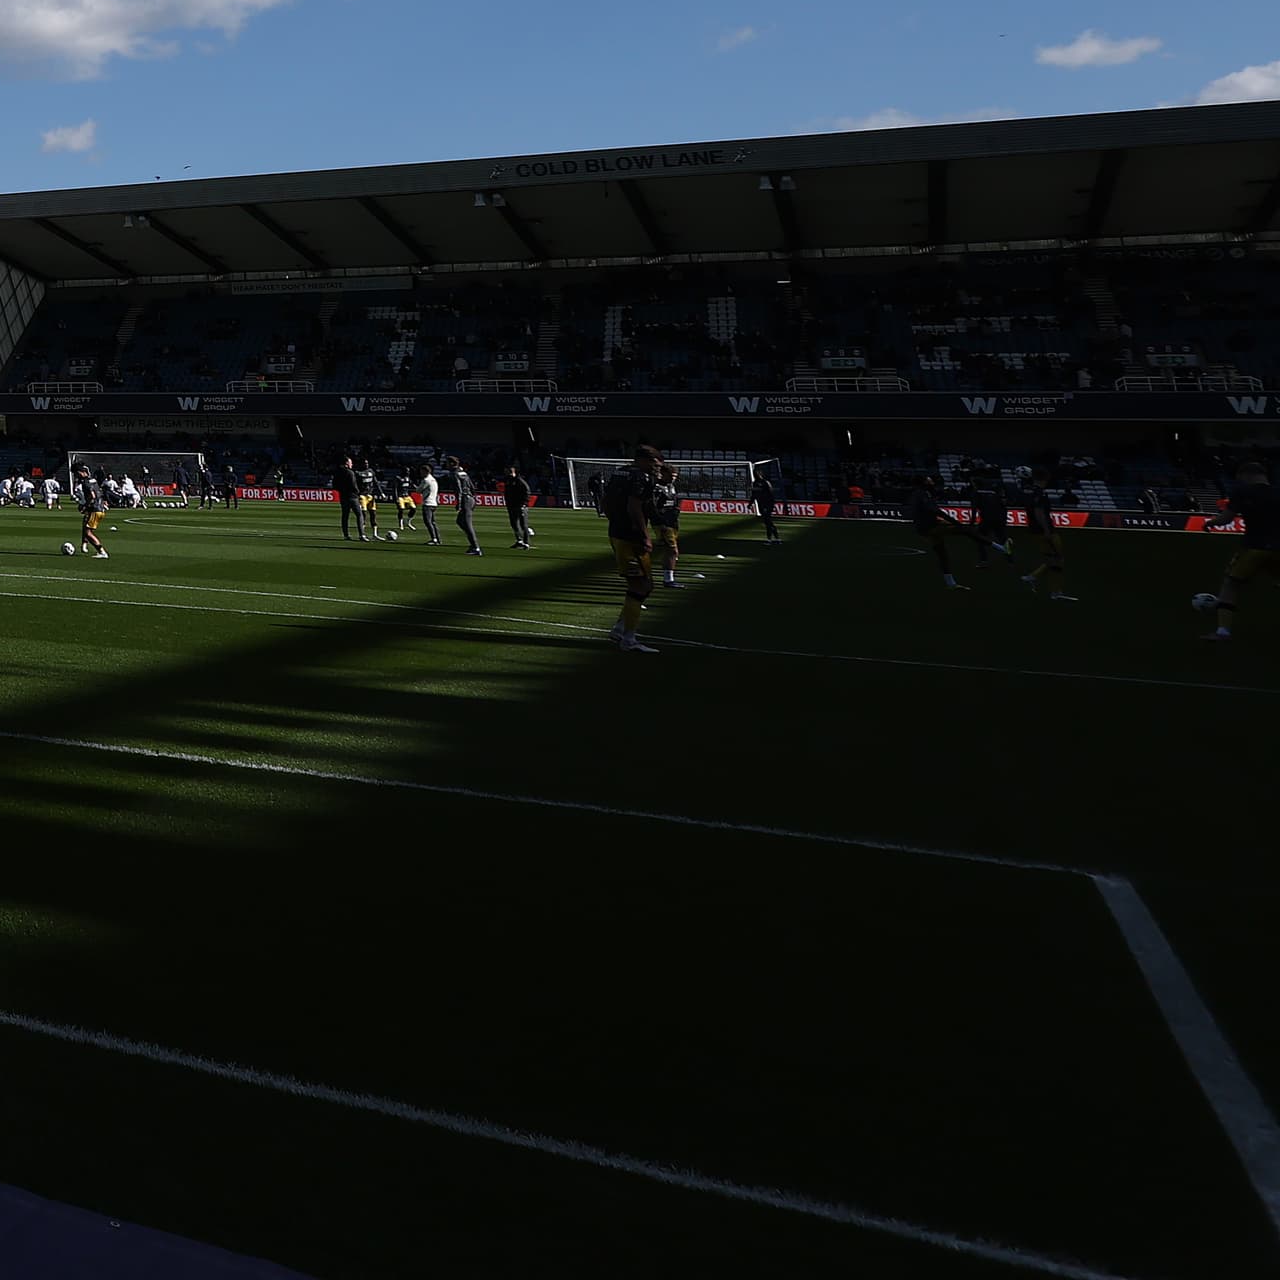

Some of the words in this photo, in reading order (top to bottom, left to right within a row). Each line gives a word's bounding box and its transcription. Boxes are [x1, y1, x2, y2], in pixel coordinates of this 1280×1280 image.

[516, 161, 578, 178] COLD
[585, 154, 654, 174] BLOW
[662, 150, 725, 168] LANE
[765, 405, 813, 414] GROUP
[1004, 406, 1057, 415] GROUP
[103, 419, 135, 429] SHOW
[139, 419, 179, 429] RACISM
[242, 488, 261, 499] FOR
[297, 490, 334, 501] EVENTS
[694, 501, 718, 513] FOR
[863, 509, 903, 517] TRAVEL
[1124, 519, 1172, 527] TRAVEL
